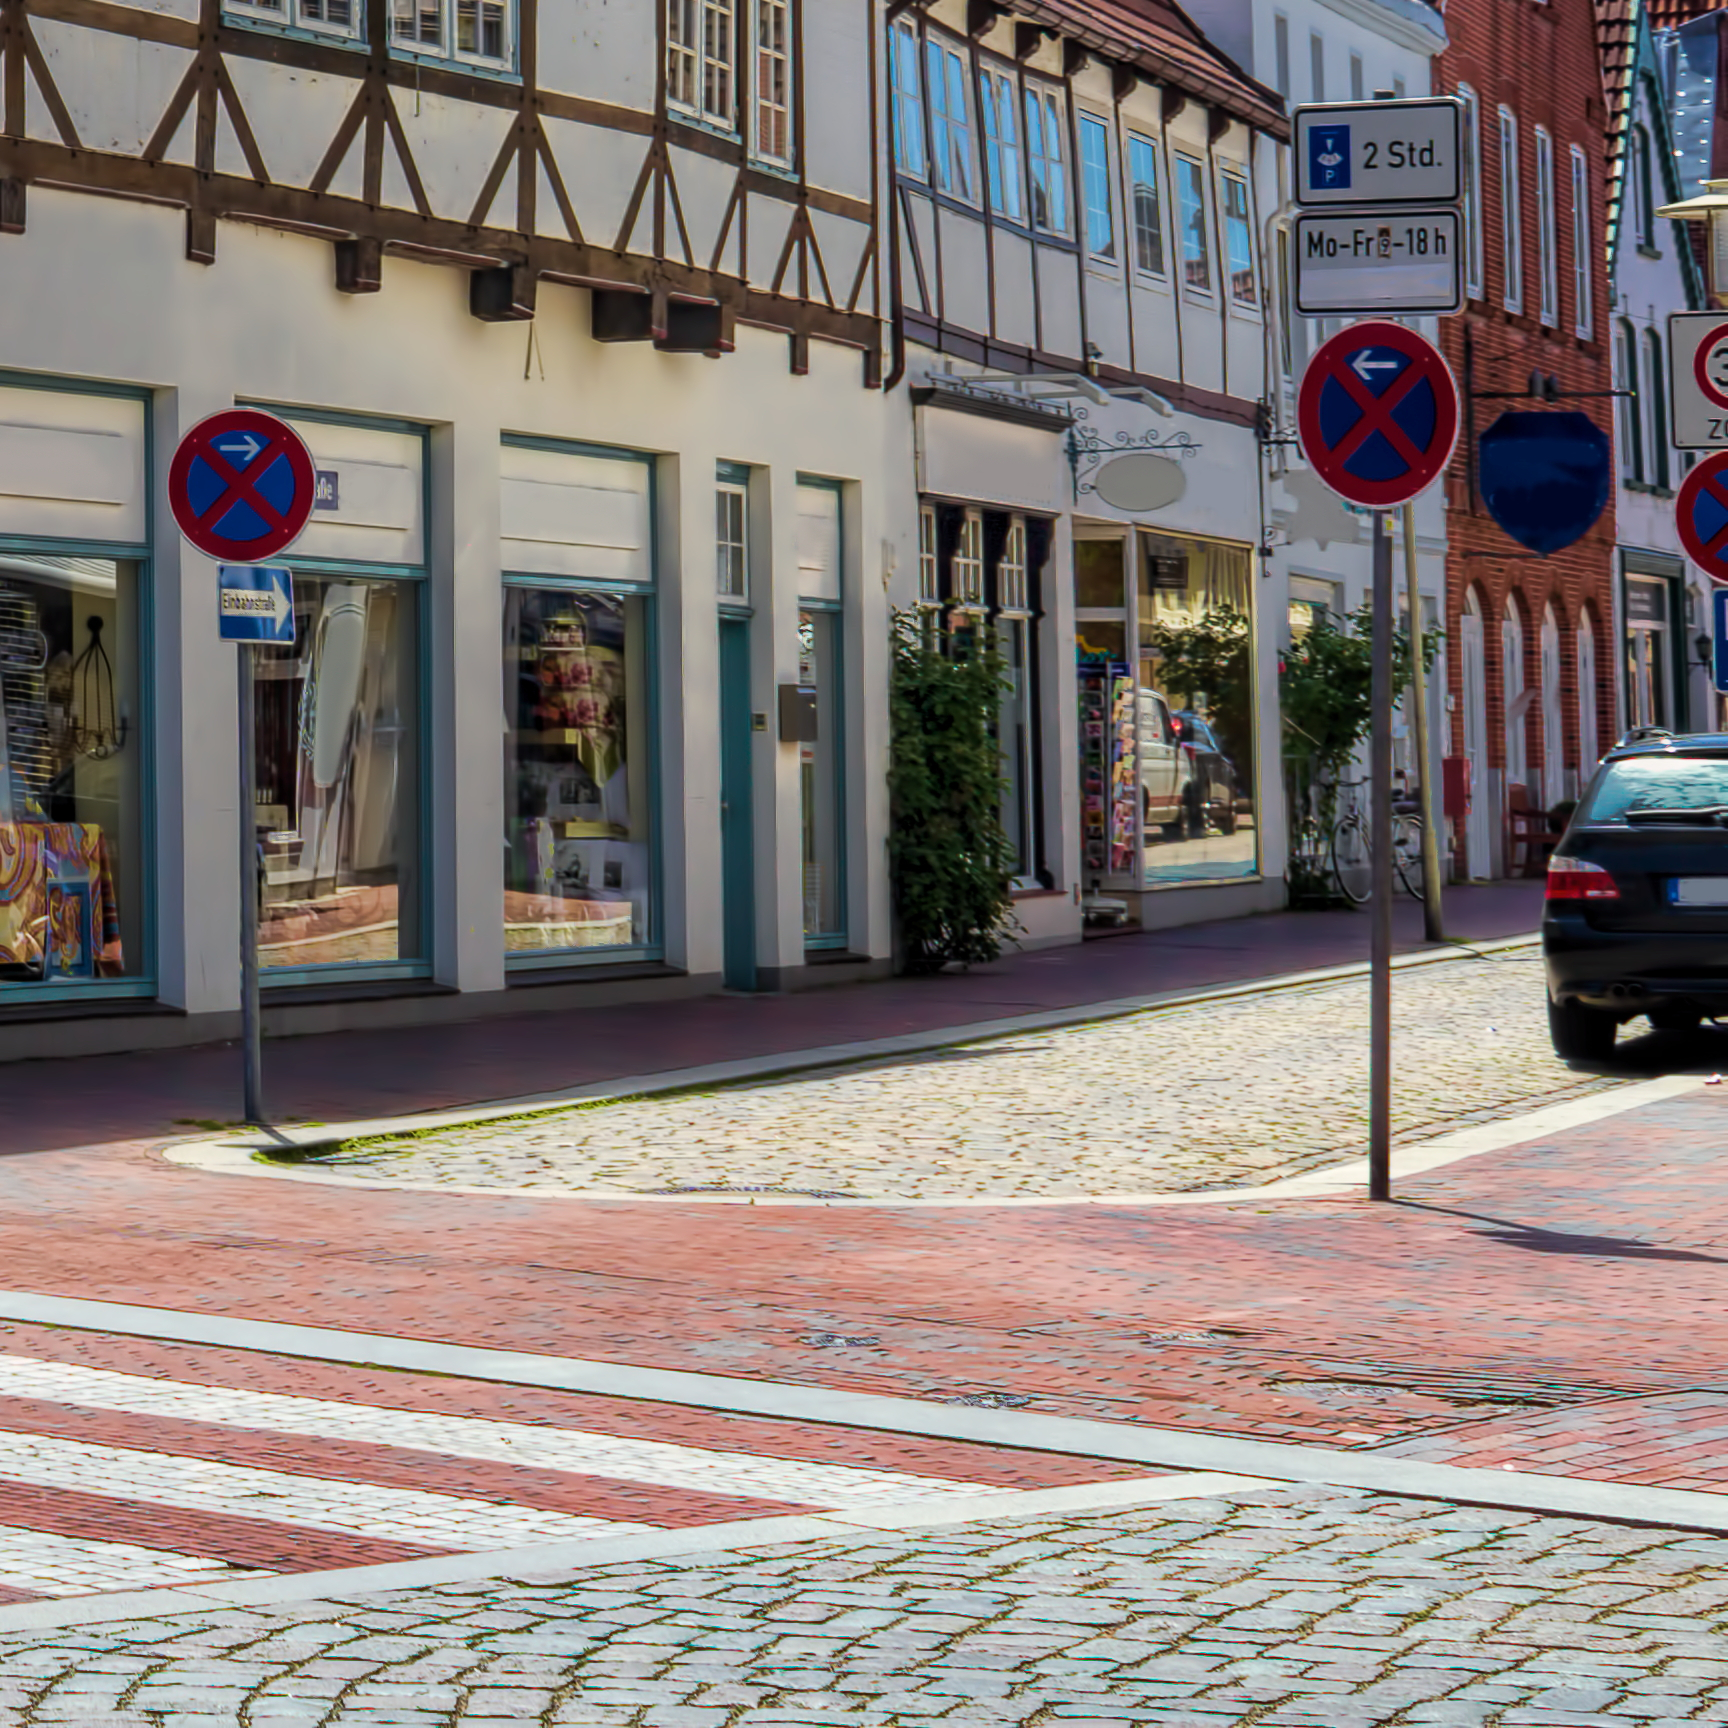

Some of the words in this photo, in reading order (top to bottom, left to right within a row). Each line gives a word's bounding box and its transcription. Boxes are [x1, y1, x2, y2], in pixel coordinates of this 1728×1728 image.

[1363, 141, 1379, 170] 2
[1387, 139, 1443, 168] Std.
[1325, 169, 1335, 183] P
